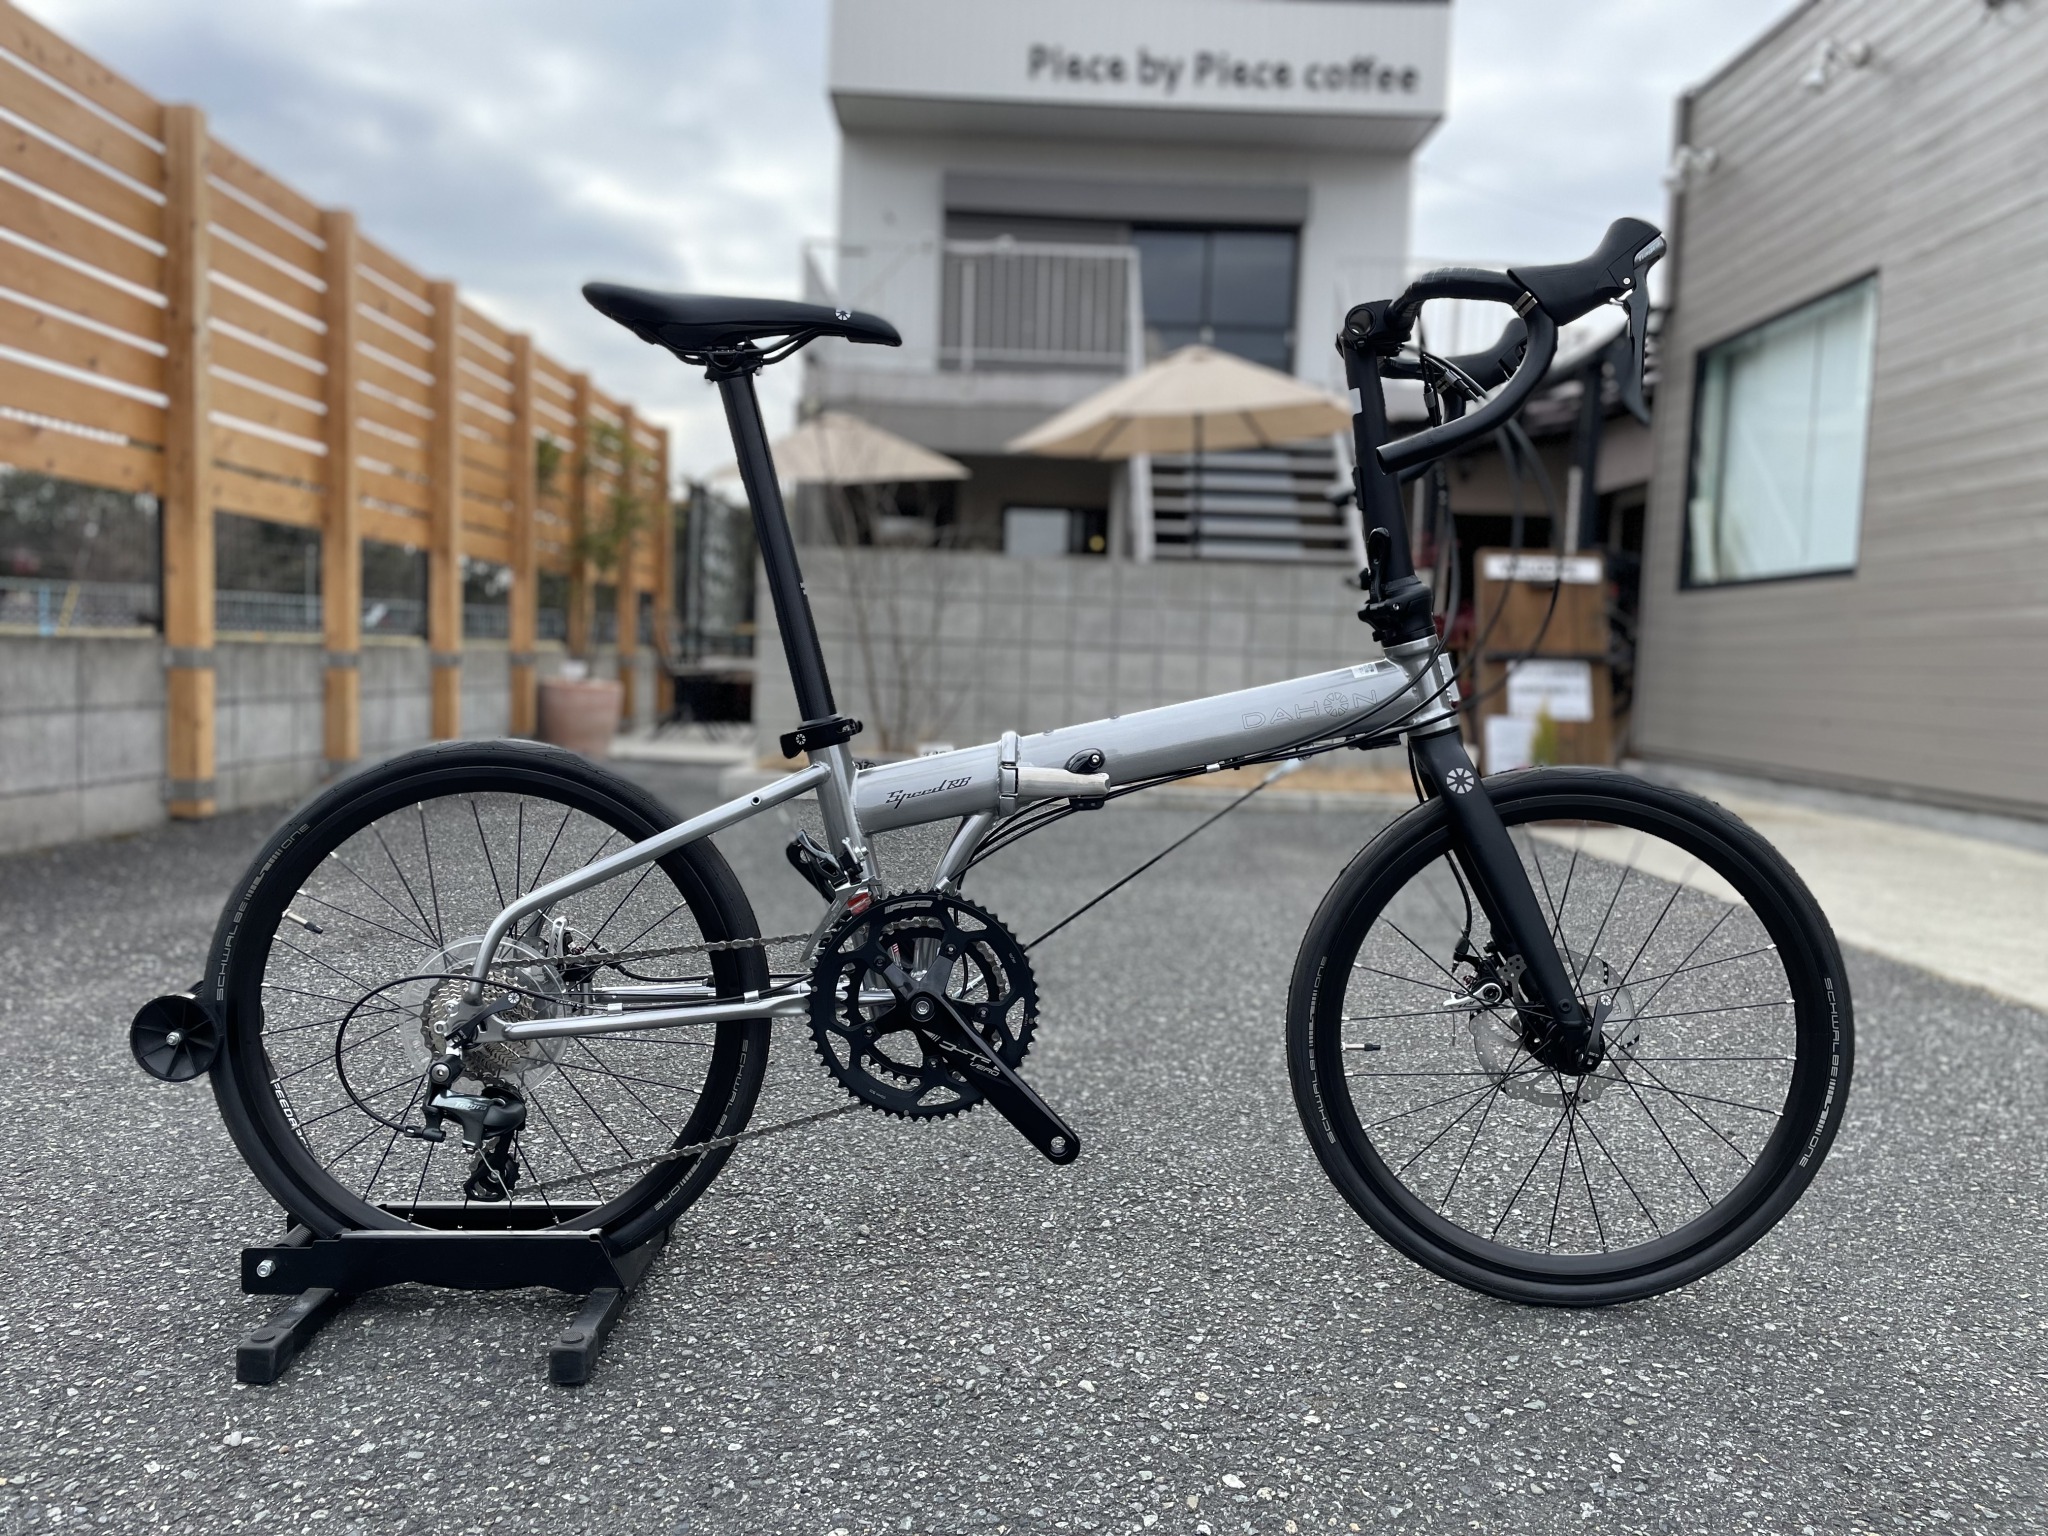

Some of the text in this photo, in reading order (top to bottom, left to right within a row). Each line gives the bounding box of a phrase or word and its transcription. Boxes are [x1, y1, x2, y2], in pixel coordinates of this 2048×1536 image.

[1027, 43, 1421, 96] Piece by Piece coffee
[1241, 689, 1378, 730] DAHON
[216, 823, 311, 1001] SCHWALBE ONE
[653, 1039, 749, 1212] SCHWALBE ONE
[1308, 956, 1337, 1145] SCHWALBE ONE
[1799, 977, 1840, 1168] SCHWALBE ONE
